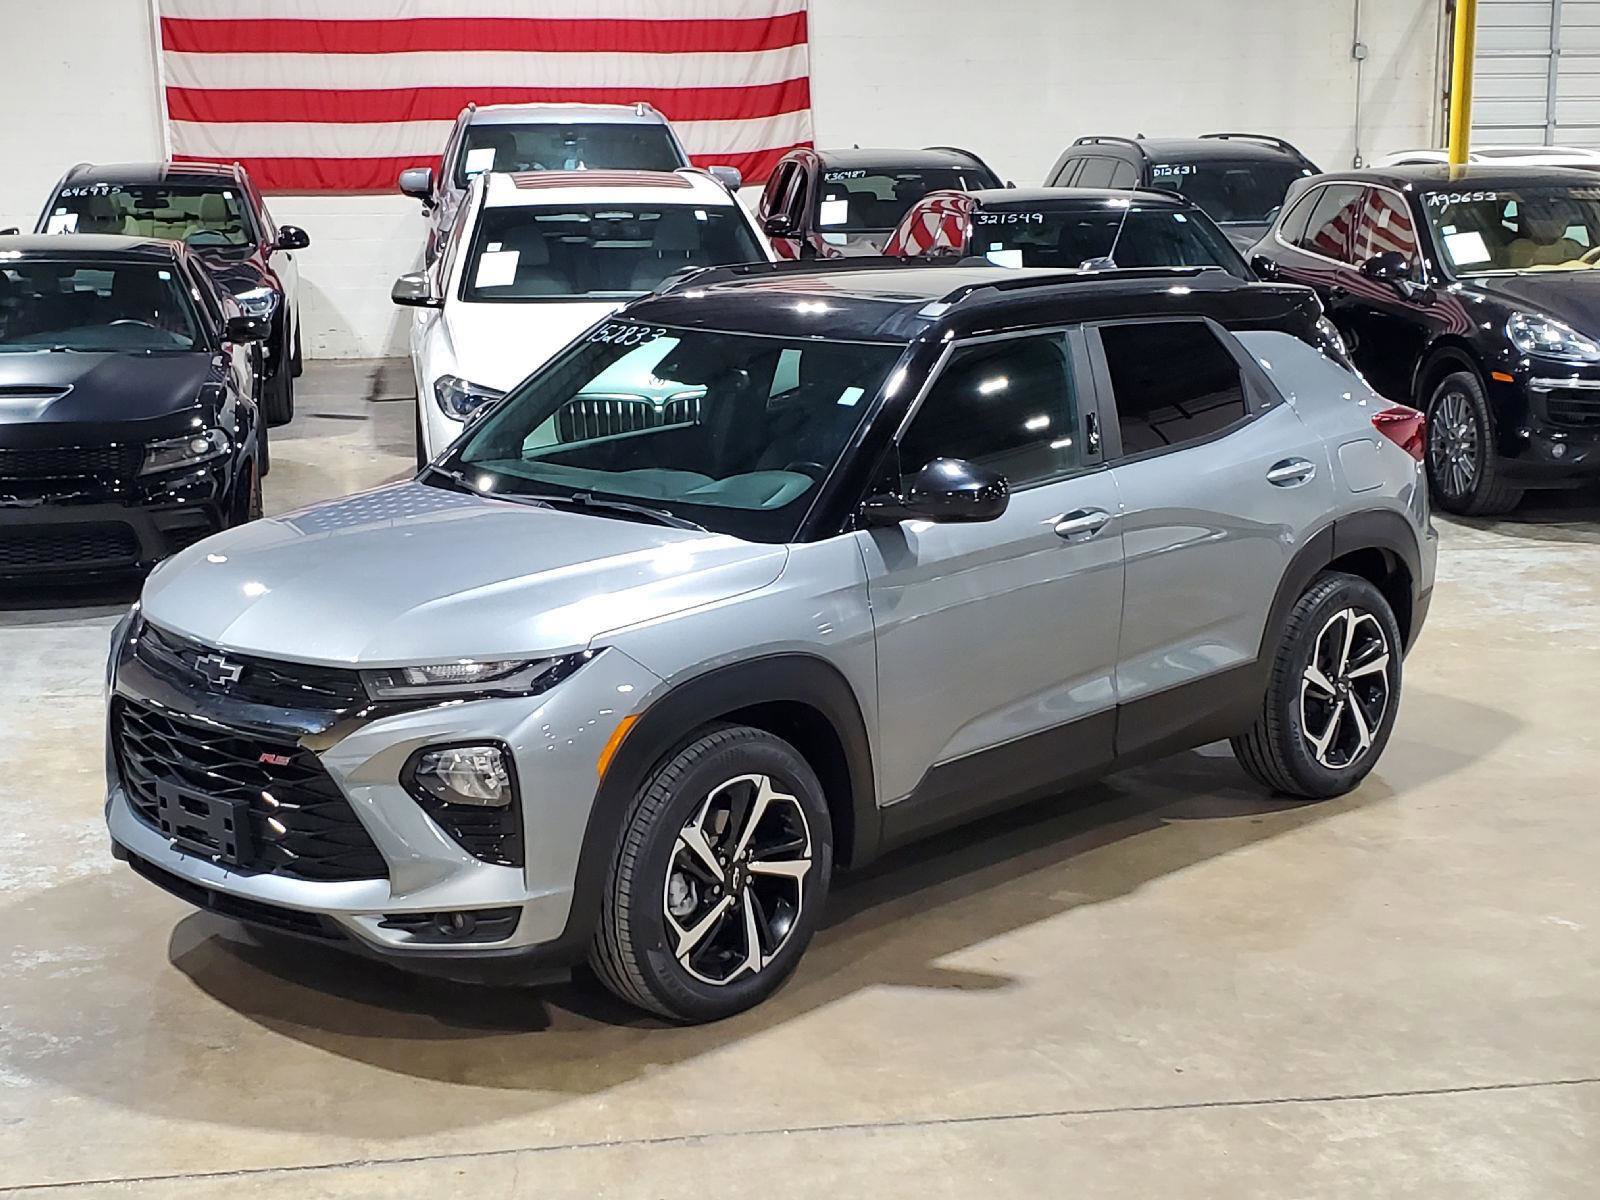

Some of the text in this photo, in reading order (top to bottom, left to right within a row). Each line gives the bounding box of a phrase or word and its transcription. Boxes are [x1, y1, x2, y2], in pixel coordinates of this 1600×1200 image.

[824, 170, 866, 182] K36487
[1427, 191, 1498, 209] A92653
[977, 213, 1044, 225] 321549
[587, 323, 667, 345] 152833
